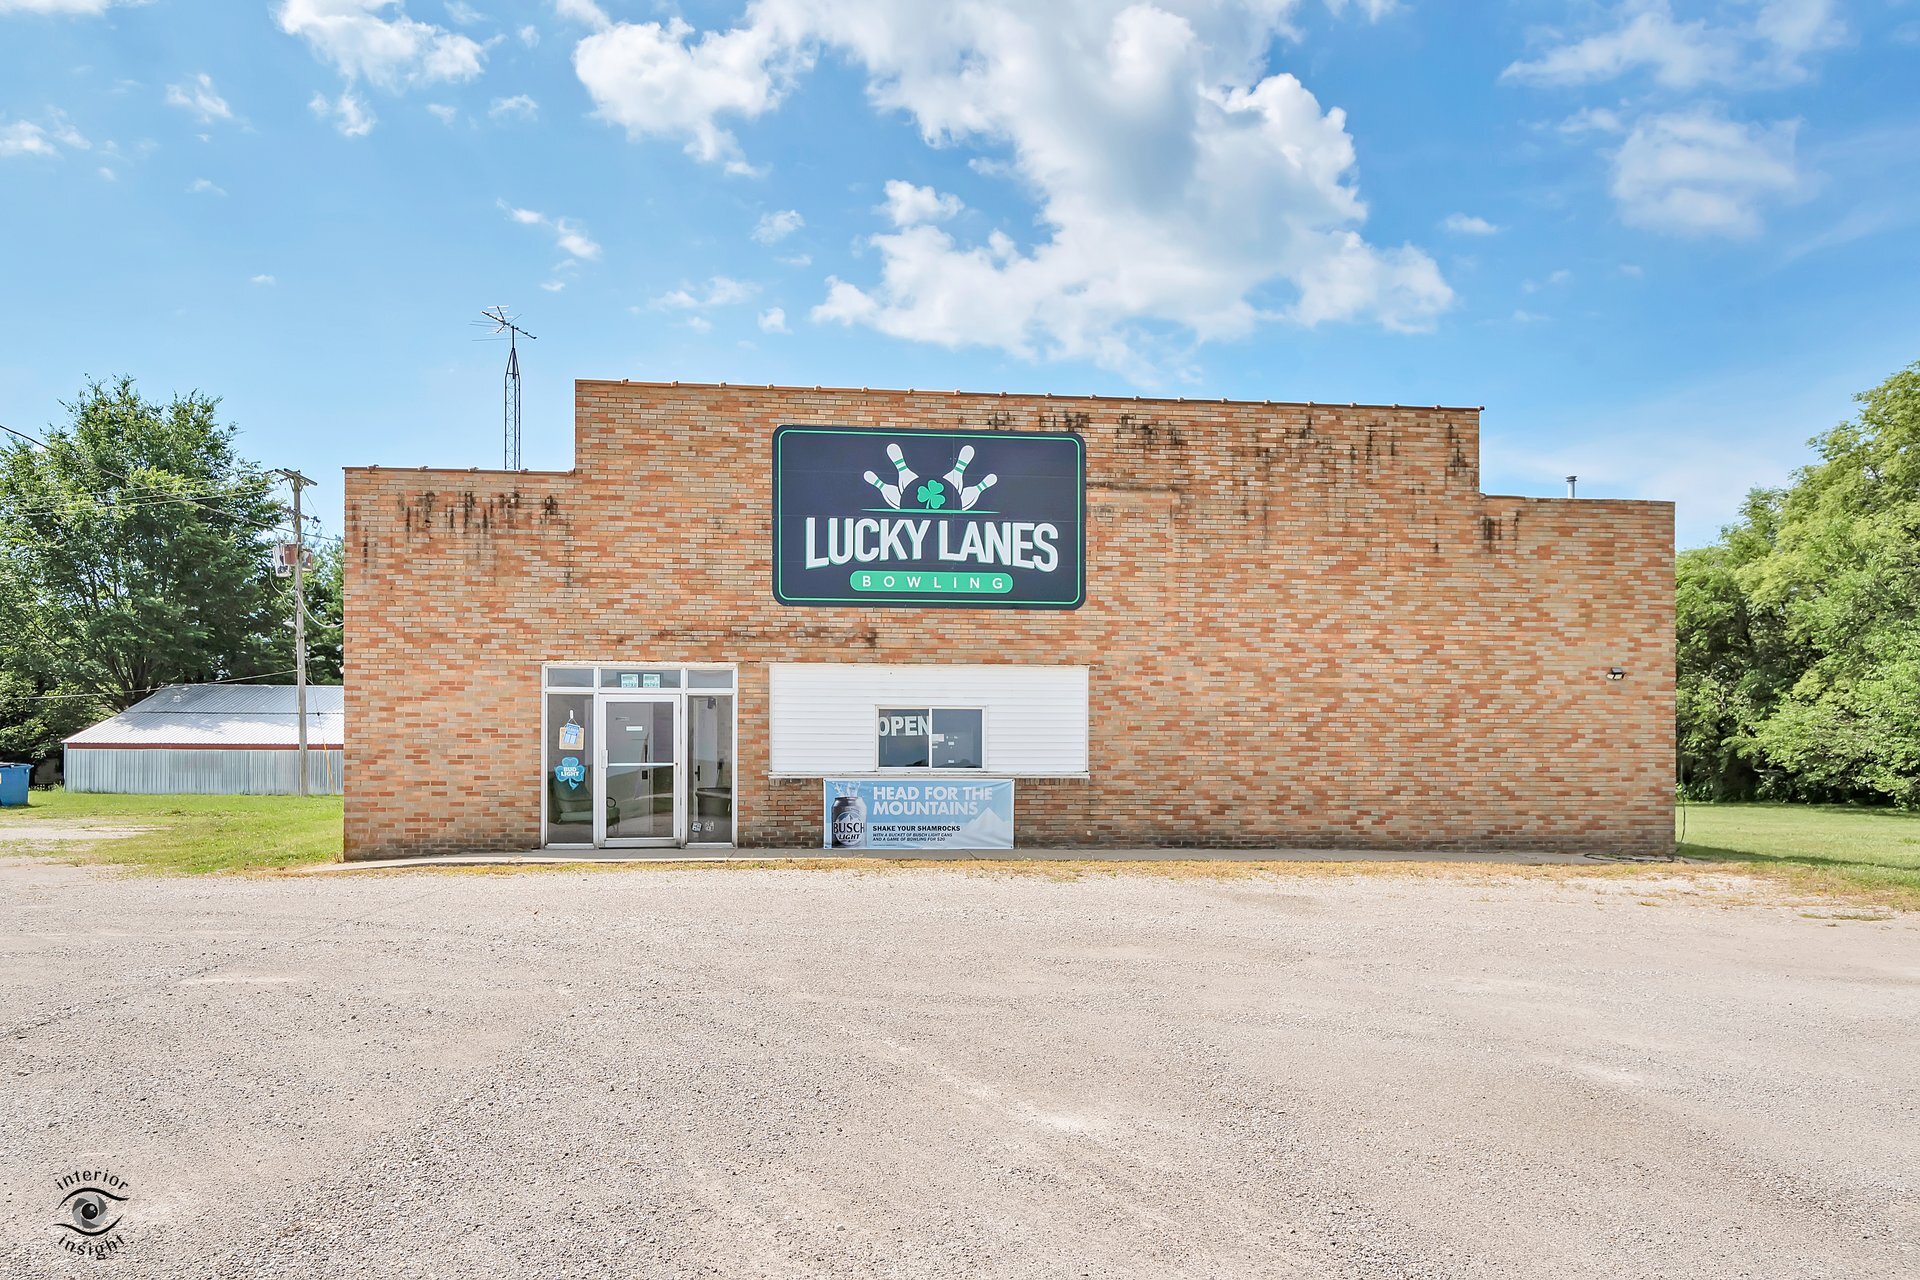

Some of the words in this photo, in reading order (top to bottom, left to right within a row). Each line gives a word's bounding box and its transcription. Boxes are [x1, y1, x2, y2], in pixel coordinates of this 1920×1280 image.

[805, 517, 931, 570] LUCKY
[938, 519, 1059, 573] LANES
[862, 575, 1003, 589] BOWLING
[879, 715, 929, 736] OPEN
[873, 786, 919, 800] HEAD
[925, 786, 958, 800] FOR
[962, 786, 993, 800] THE
[873, 801, 978, 815] MOUNTAINS
[833, 822, 864, 833] BUSCH
